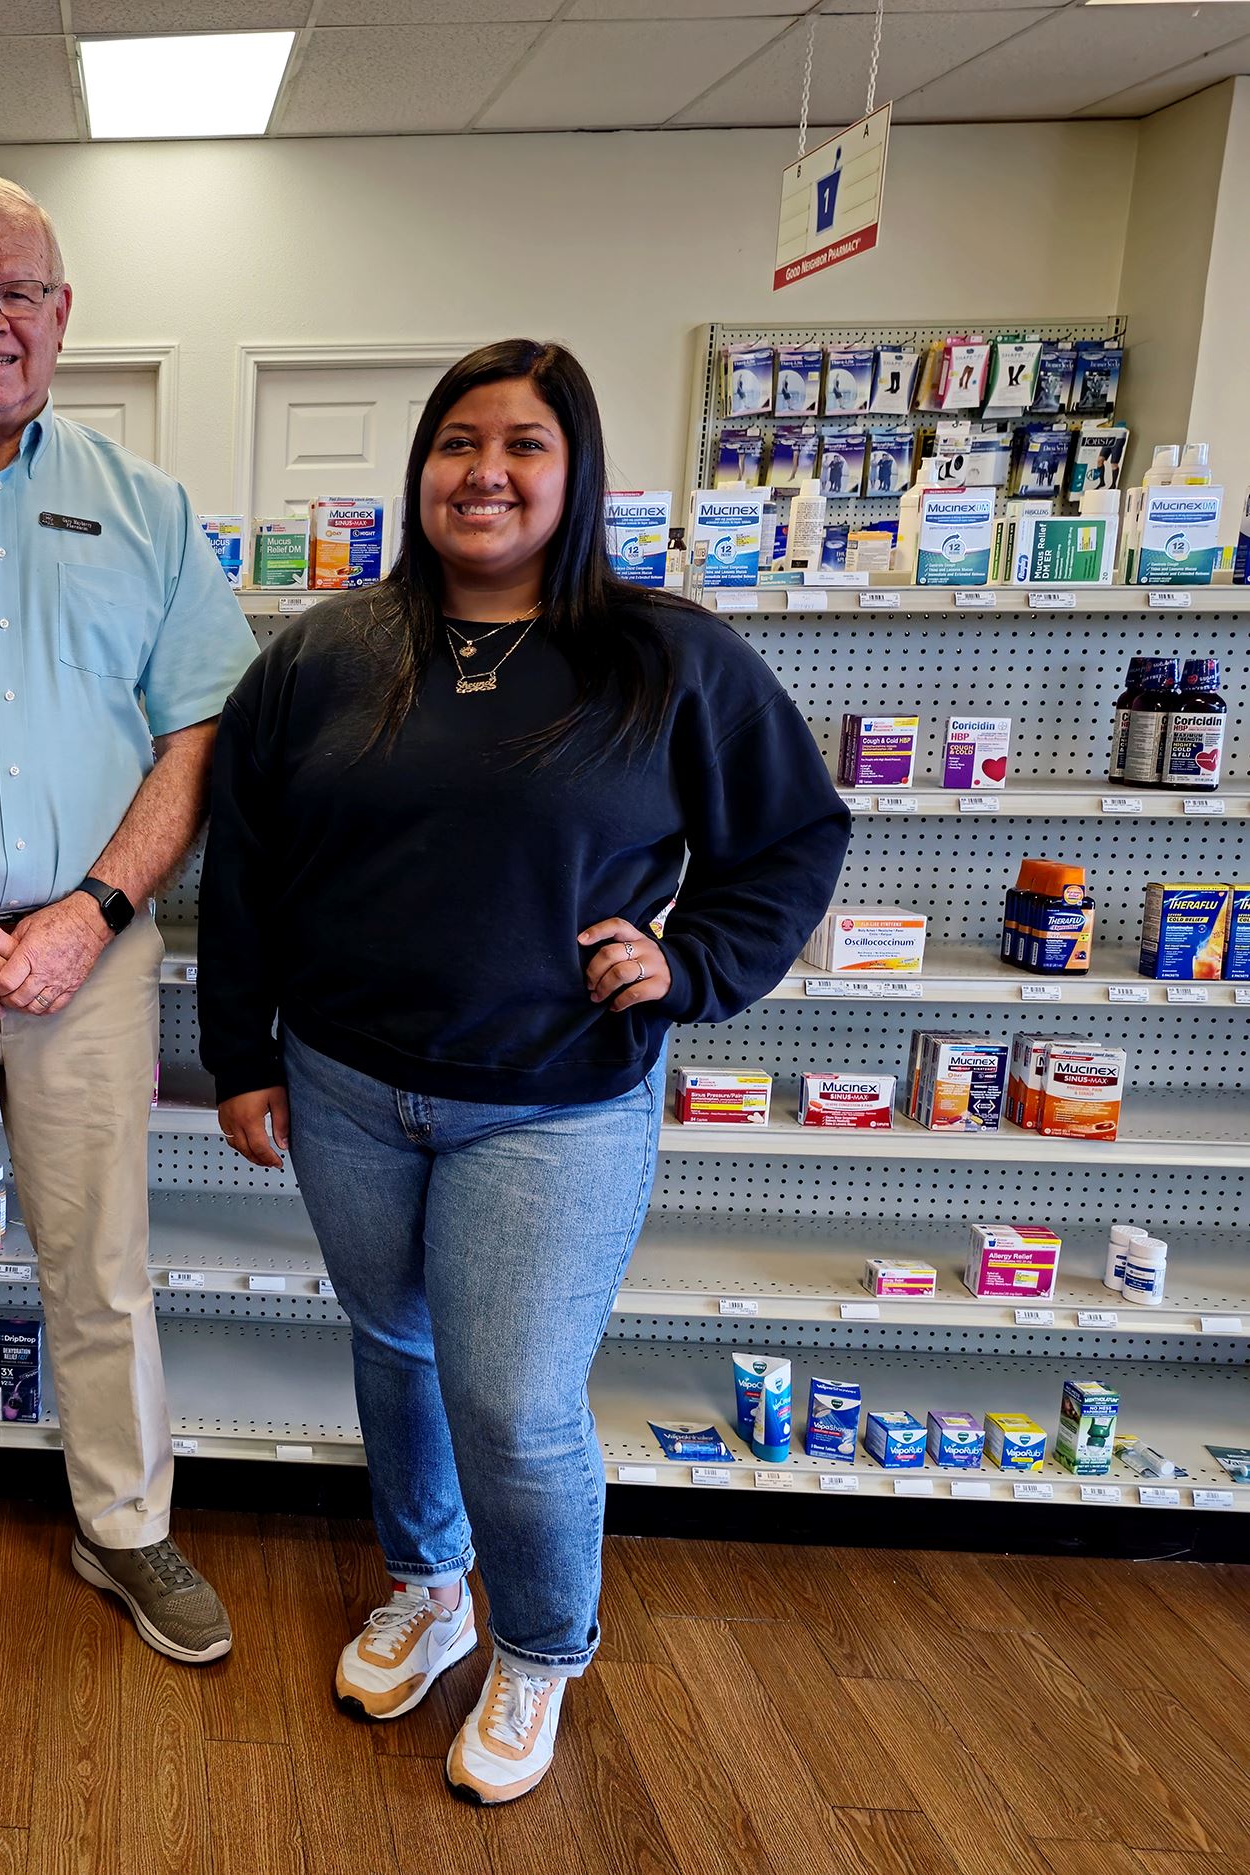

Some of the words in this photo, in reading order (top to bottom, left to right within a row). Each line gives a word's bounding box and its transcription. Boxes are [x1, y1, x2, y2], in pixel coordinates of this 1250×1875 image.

[863, 124, 870, 139] A
[823, 187, 831, 214] 1
[608, 505, 665, 517] Mucinex
[701, 504, 758, 515] Mucinex
[928, 504, 976, 513] Mucinex
[1151, 501, 1202, 511] Mucinex
[330, 510, 373, 518] Mucinex
[1038, 523, 1047, 549] Relief
[267, 545, 287, 553] Relief
[720, 545, 732, 553] 12
[1172, 542, 1185, 550] 12
[1044, 550, 1053, 562] ER
[1034, 551, 1044, 579] Mucus
[1042, 564, 1051, 579] DM
[952, 720, 995, 730] Coricidin
[1174, 715, 1222, 725] Coricidin
[862, 737, 879, 745] Cough
[951, 733, 970, 741] HBP
[1168, 900, 1218, 910] THERAFLU
[1048, 916, 1082, 925] THERAFLU
[844, 937, 915, 947] Oscillococcinum
[951, 1056, 996, 1066] Mucinex
[1056, 1062, 1117, 1076] Mucinex
[1064, 1075, 1108, 1085] SINUS-MAX
[822, 1081, 877, 1093] Mucinex
[830, 1093, 868, 1101] SINUS-MAX
[988, 1253, 1013, 1261] Allergy
[4, 1335, 36, 1344] DripDrop
[2, 1347, 31, 1355] DEHYDRATION
[0, 1367, 14, 1377] 3X
[890, 1446, 923, 1455] VapoRub
[944, 1446, 979, 1455] VapoRub
[1006, 1448, 1042, 1457] VapoRub
